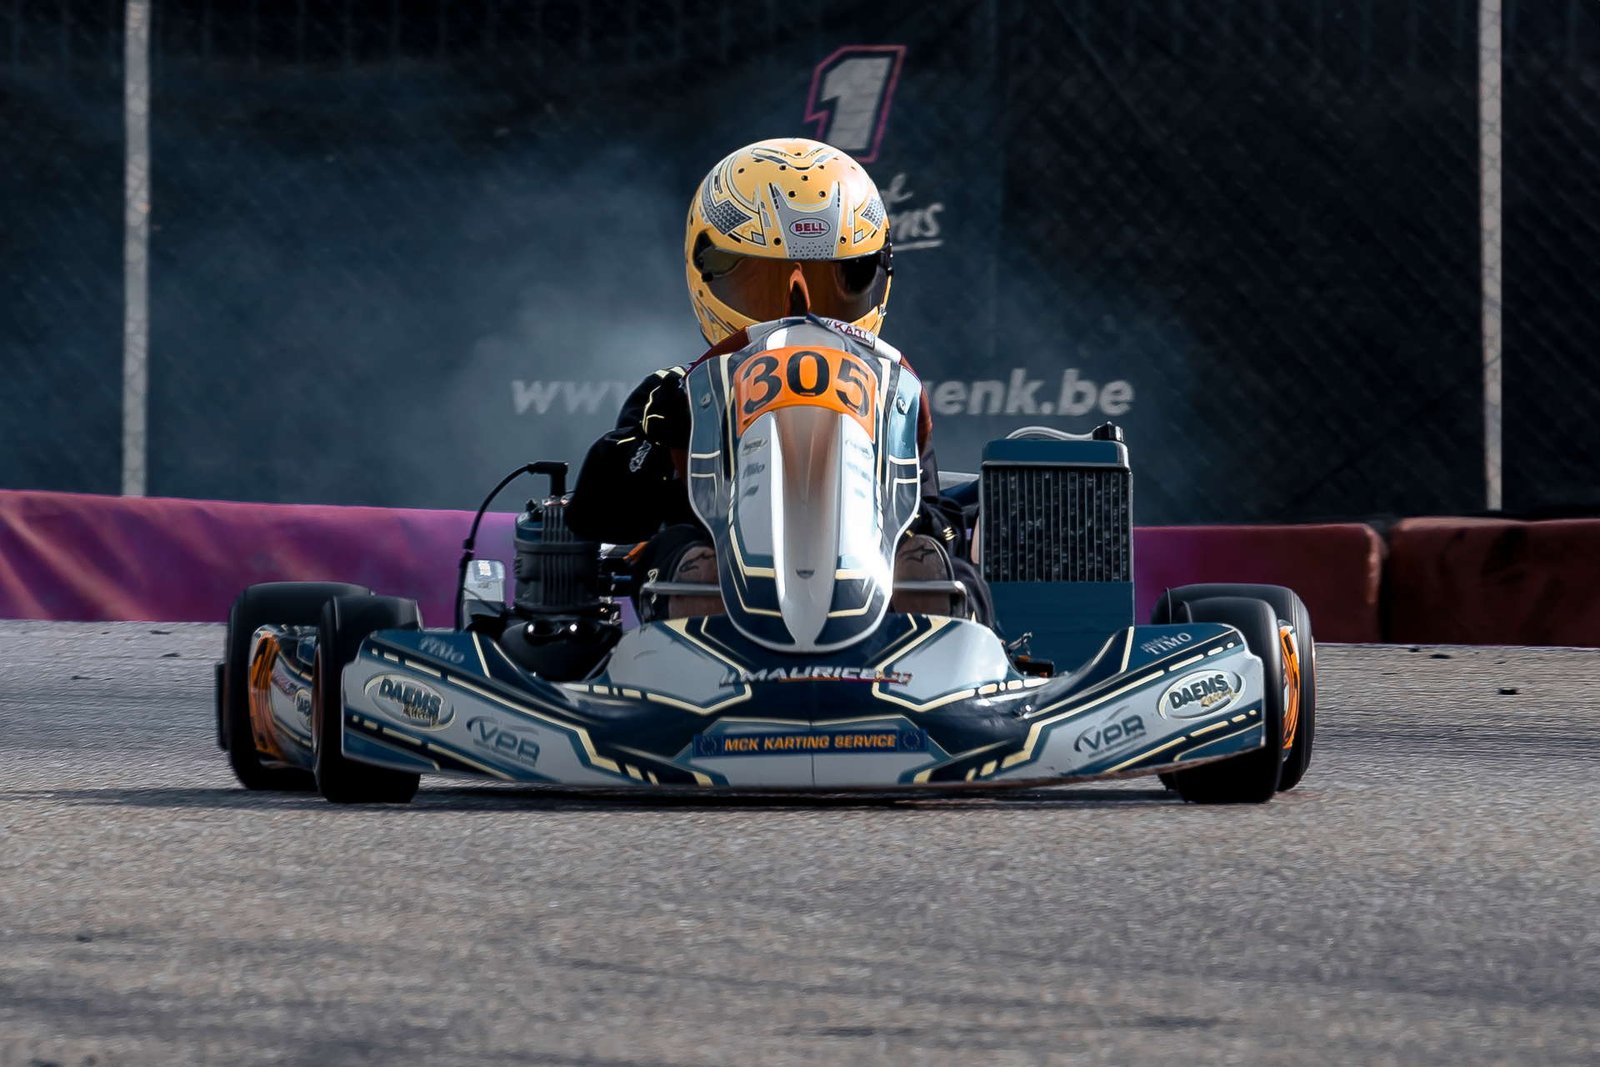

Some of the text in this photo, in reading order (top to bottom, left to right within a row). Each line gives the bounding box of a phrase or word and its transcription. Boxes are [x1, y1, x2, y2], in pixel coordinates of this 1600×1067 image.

[816, 53, 895, 151] 1
[795, 222, 827, 233] BELL
[742, 350, 870, 418] 305
[924, 367, 1135, 416] enk.be
[378, 678, 442, 716] DAEMS
[1168, 674, 1229, 709] DAEMS
[763, 735, 830, 750] KARTING
[833, 733, 897, 748] SERVICE
[1081, 714, 1145, 750] VPR
